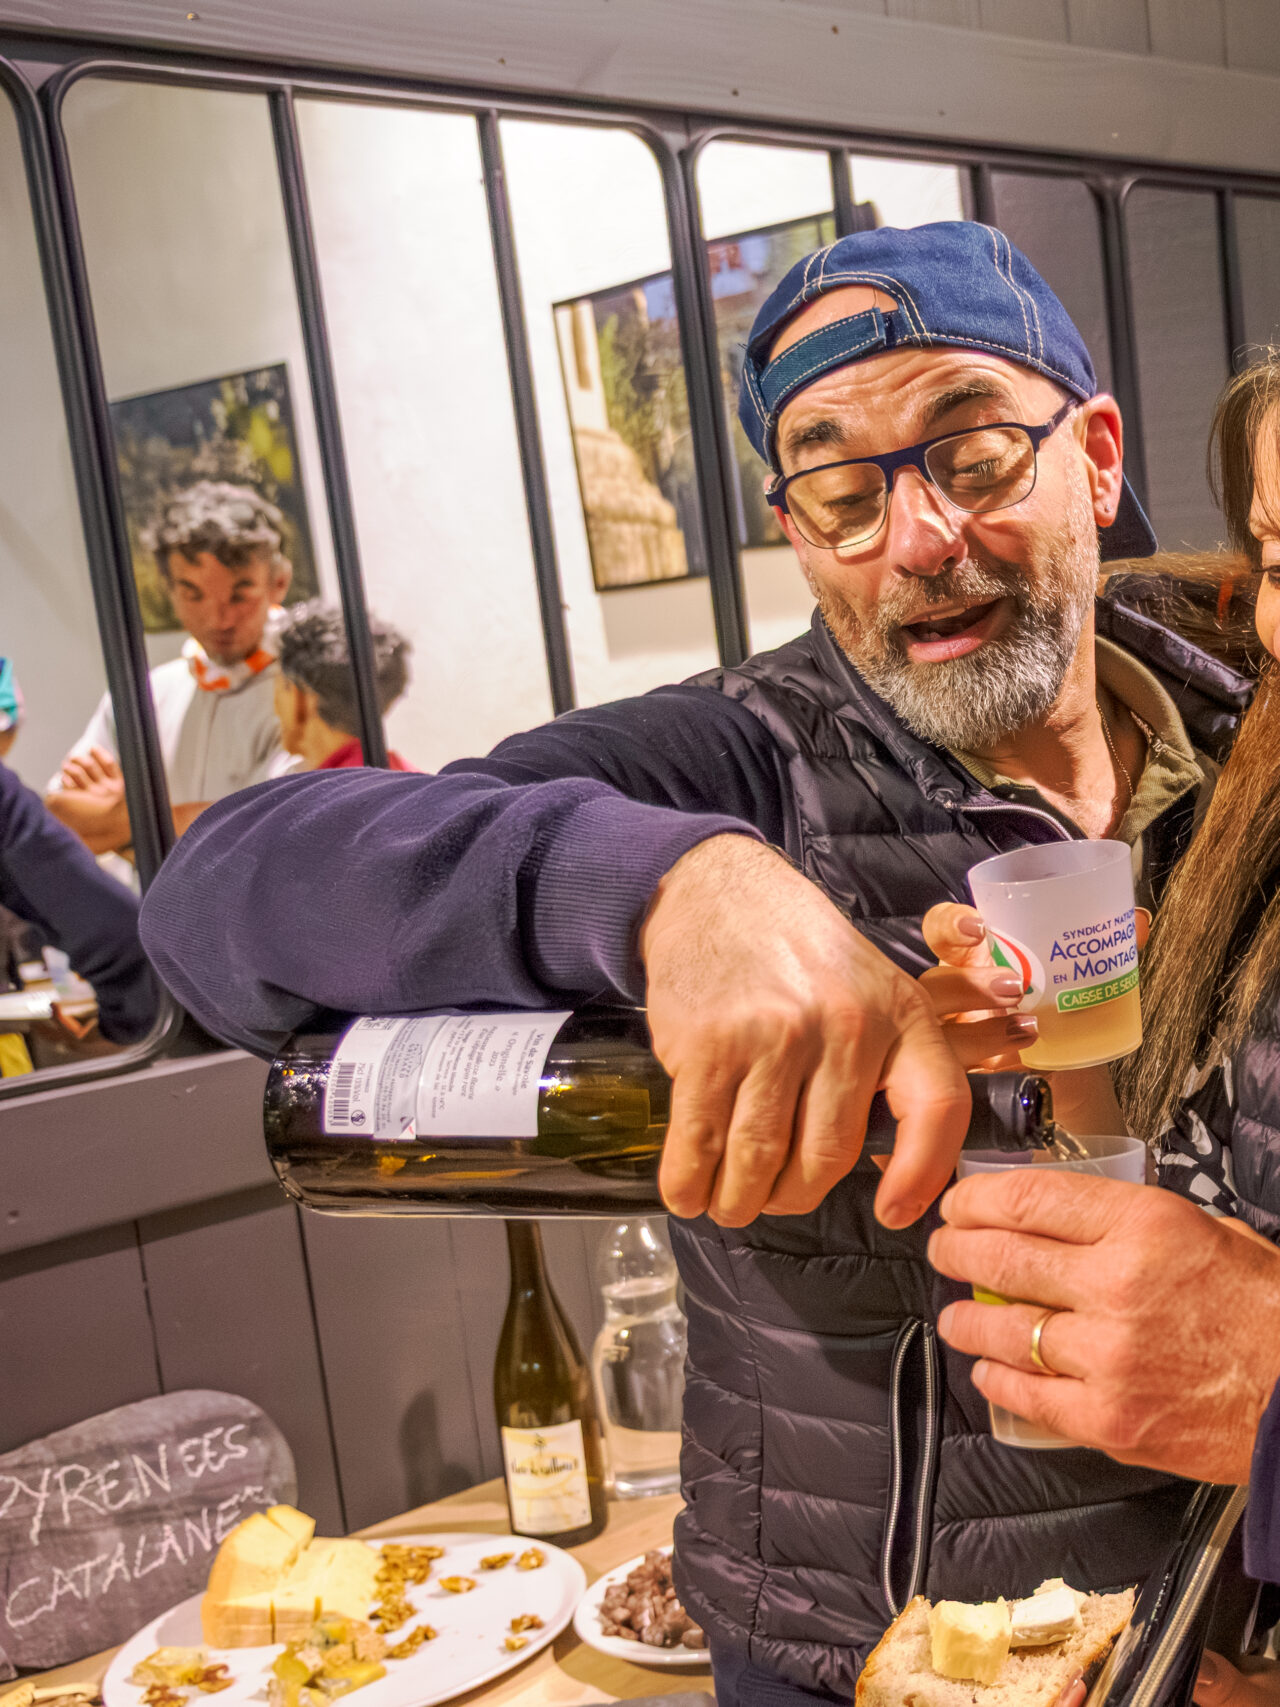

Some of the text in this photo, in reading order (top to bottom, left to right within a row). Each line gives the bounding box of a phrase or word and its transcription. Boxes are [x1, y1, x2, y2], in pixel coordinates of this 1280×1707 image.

[1063, 920, 1111, 940] SYNDICAT
[1053, 945, 1137, 984] EN MONTAG
[1062, 988, 1103, 1007] CAISSE
[1104, 982, 1119, 997] DE
